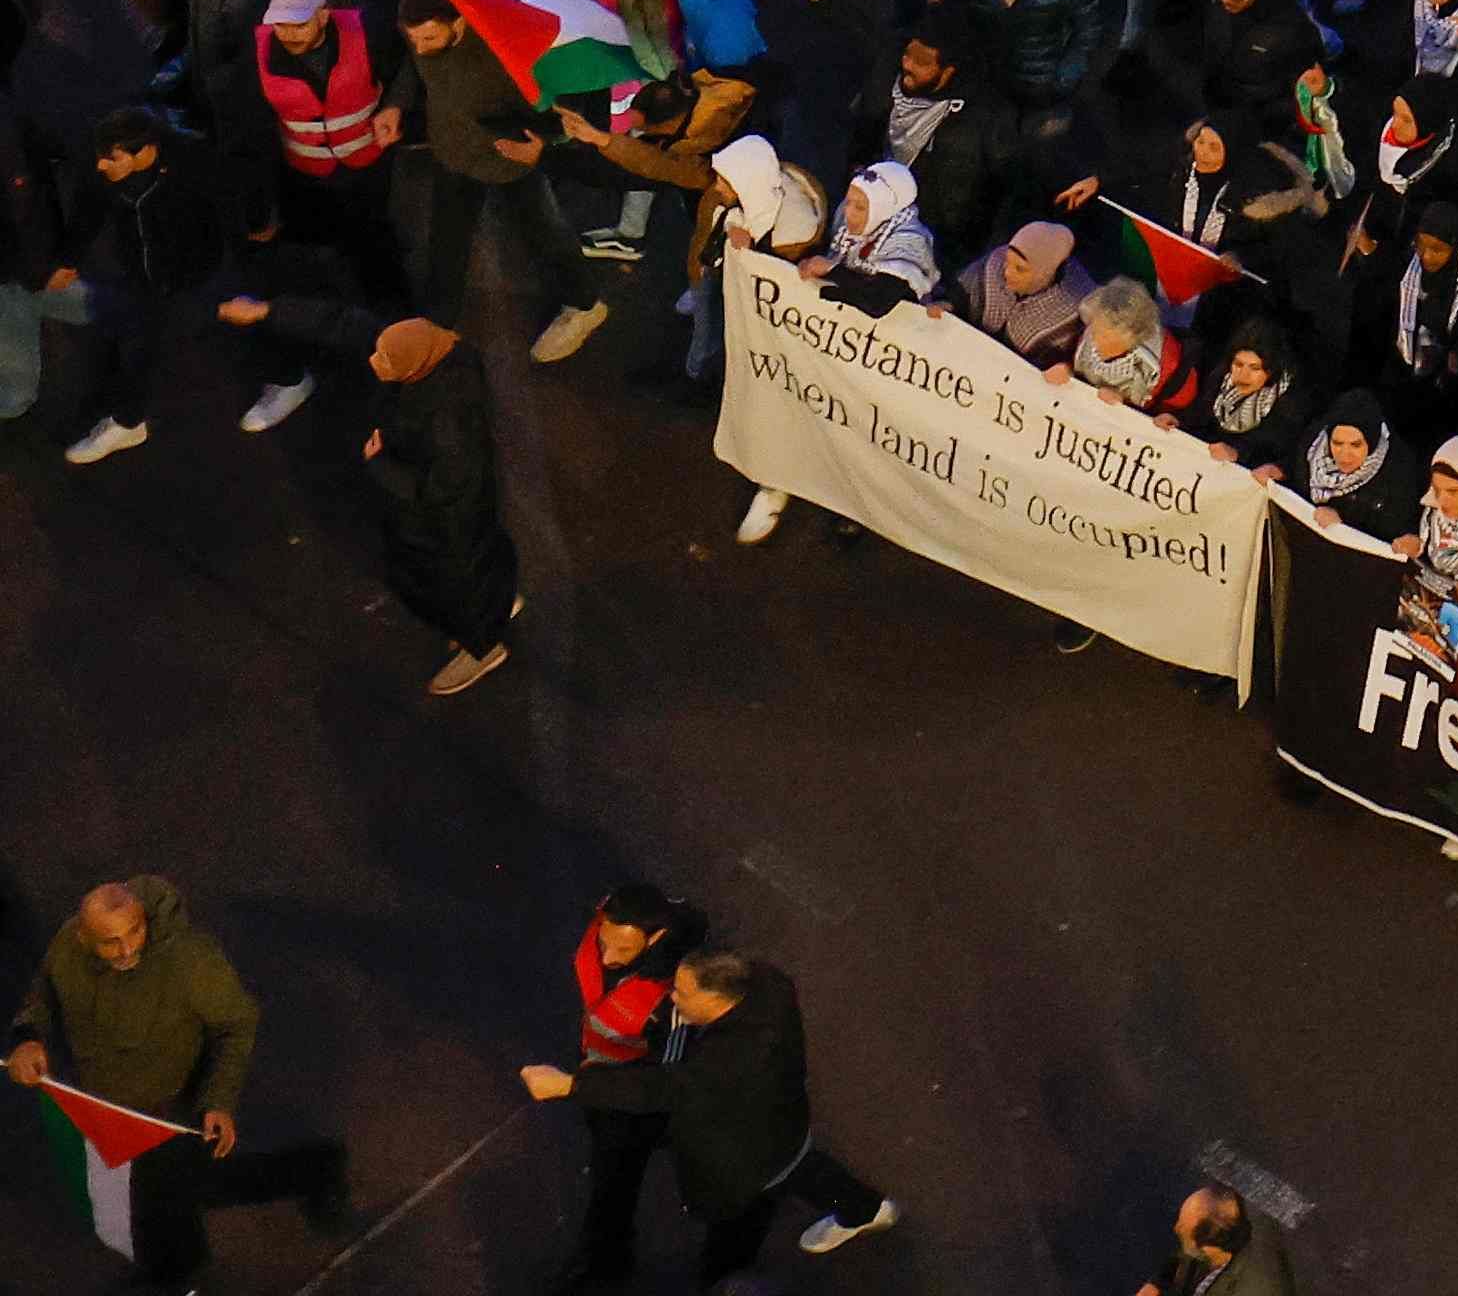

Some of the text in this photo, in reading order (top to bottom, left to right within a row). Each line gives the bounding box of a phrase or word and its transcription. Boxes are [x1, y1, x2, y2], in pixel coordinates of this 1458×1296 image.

[747, 348, 1230, 586] when land is occupied!
[750, 274, 1201, 516] Resistance is justified
